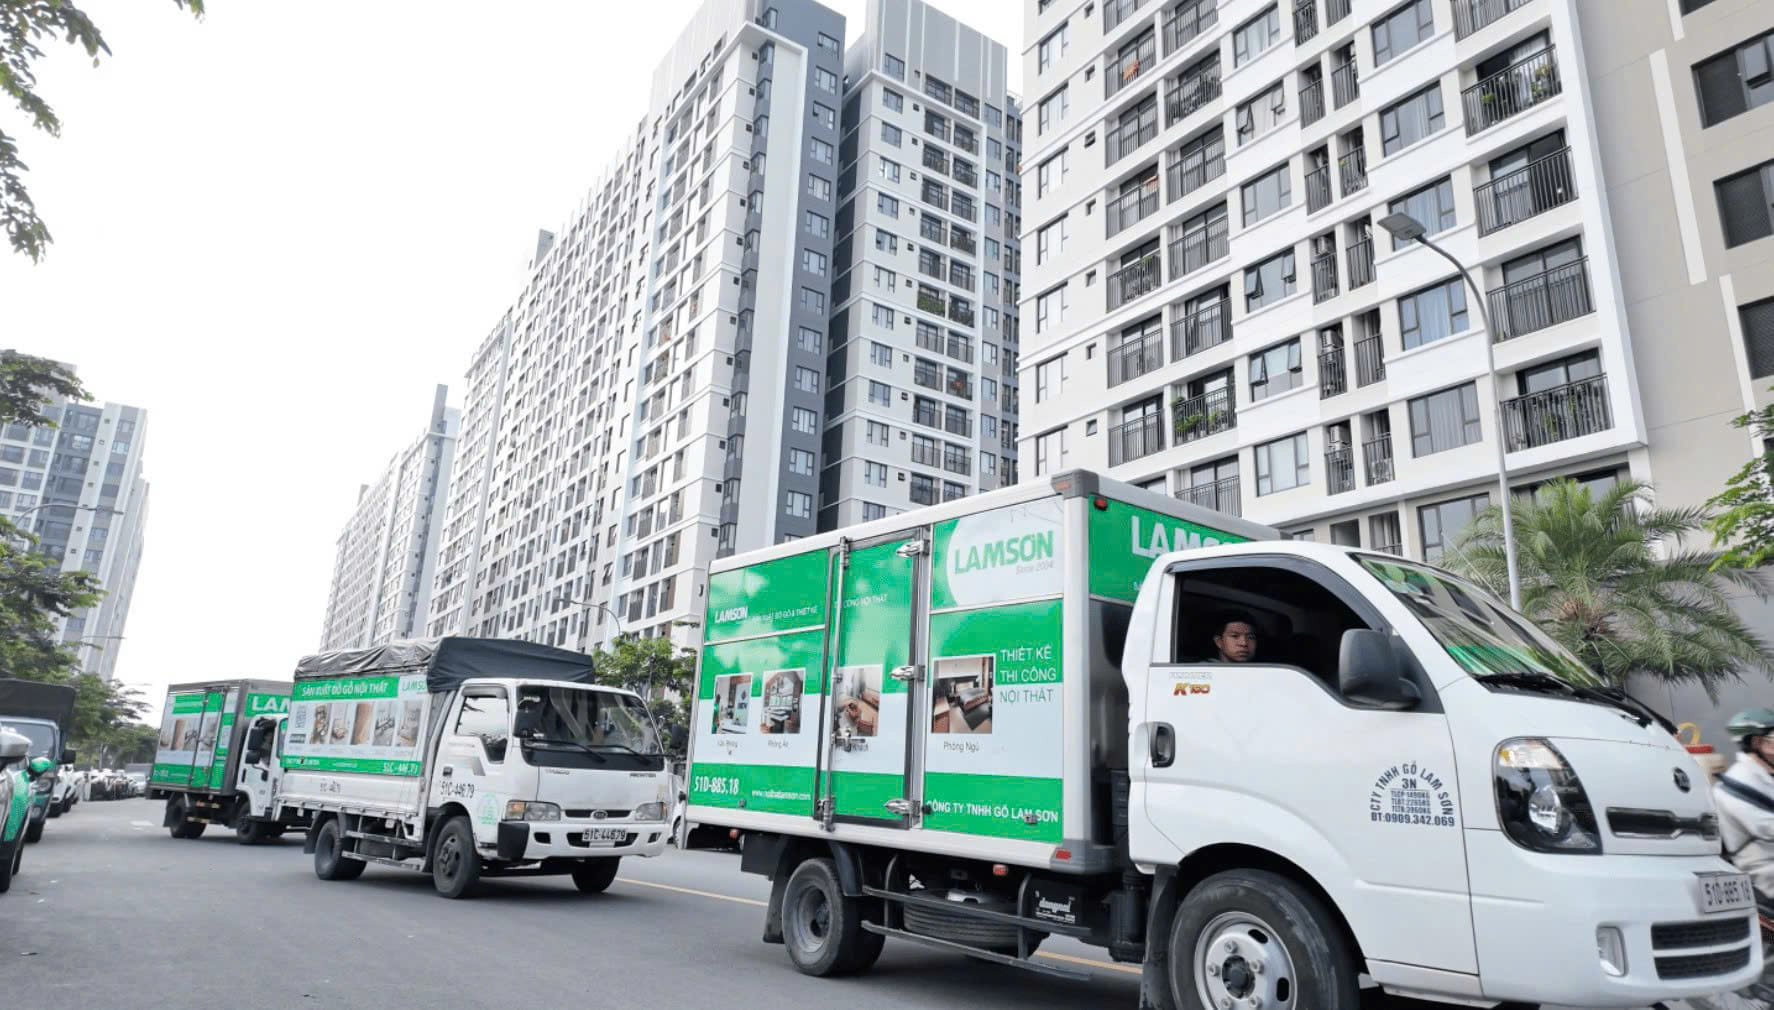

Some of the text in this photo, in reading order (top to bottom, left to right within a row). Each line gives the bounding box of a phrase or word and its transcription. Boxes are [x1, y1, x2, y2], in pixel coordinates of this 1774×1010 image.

[1131, 515, 1234, 559] LAM
[1000, 643, 1053, 662] THIẾT KẾ
[1000, 665, 1057, 682] THI CÔNG
[1000, 688, 1020, 706] NỘI
[1402, 778, 1417, 789] 3N
[1420, 768, 1443, 790] LAM
[953, 802, 964, 814] TY
[966, 803, 992, 817] TNHH
[1011, 807, 1032, 820] LAM
